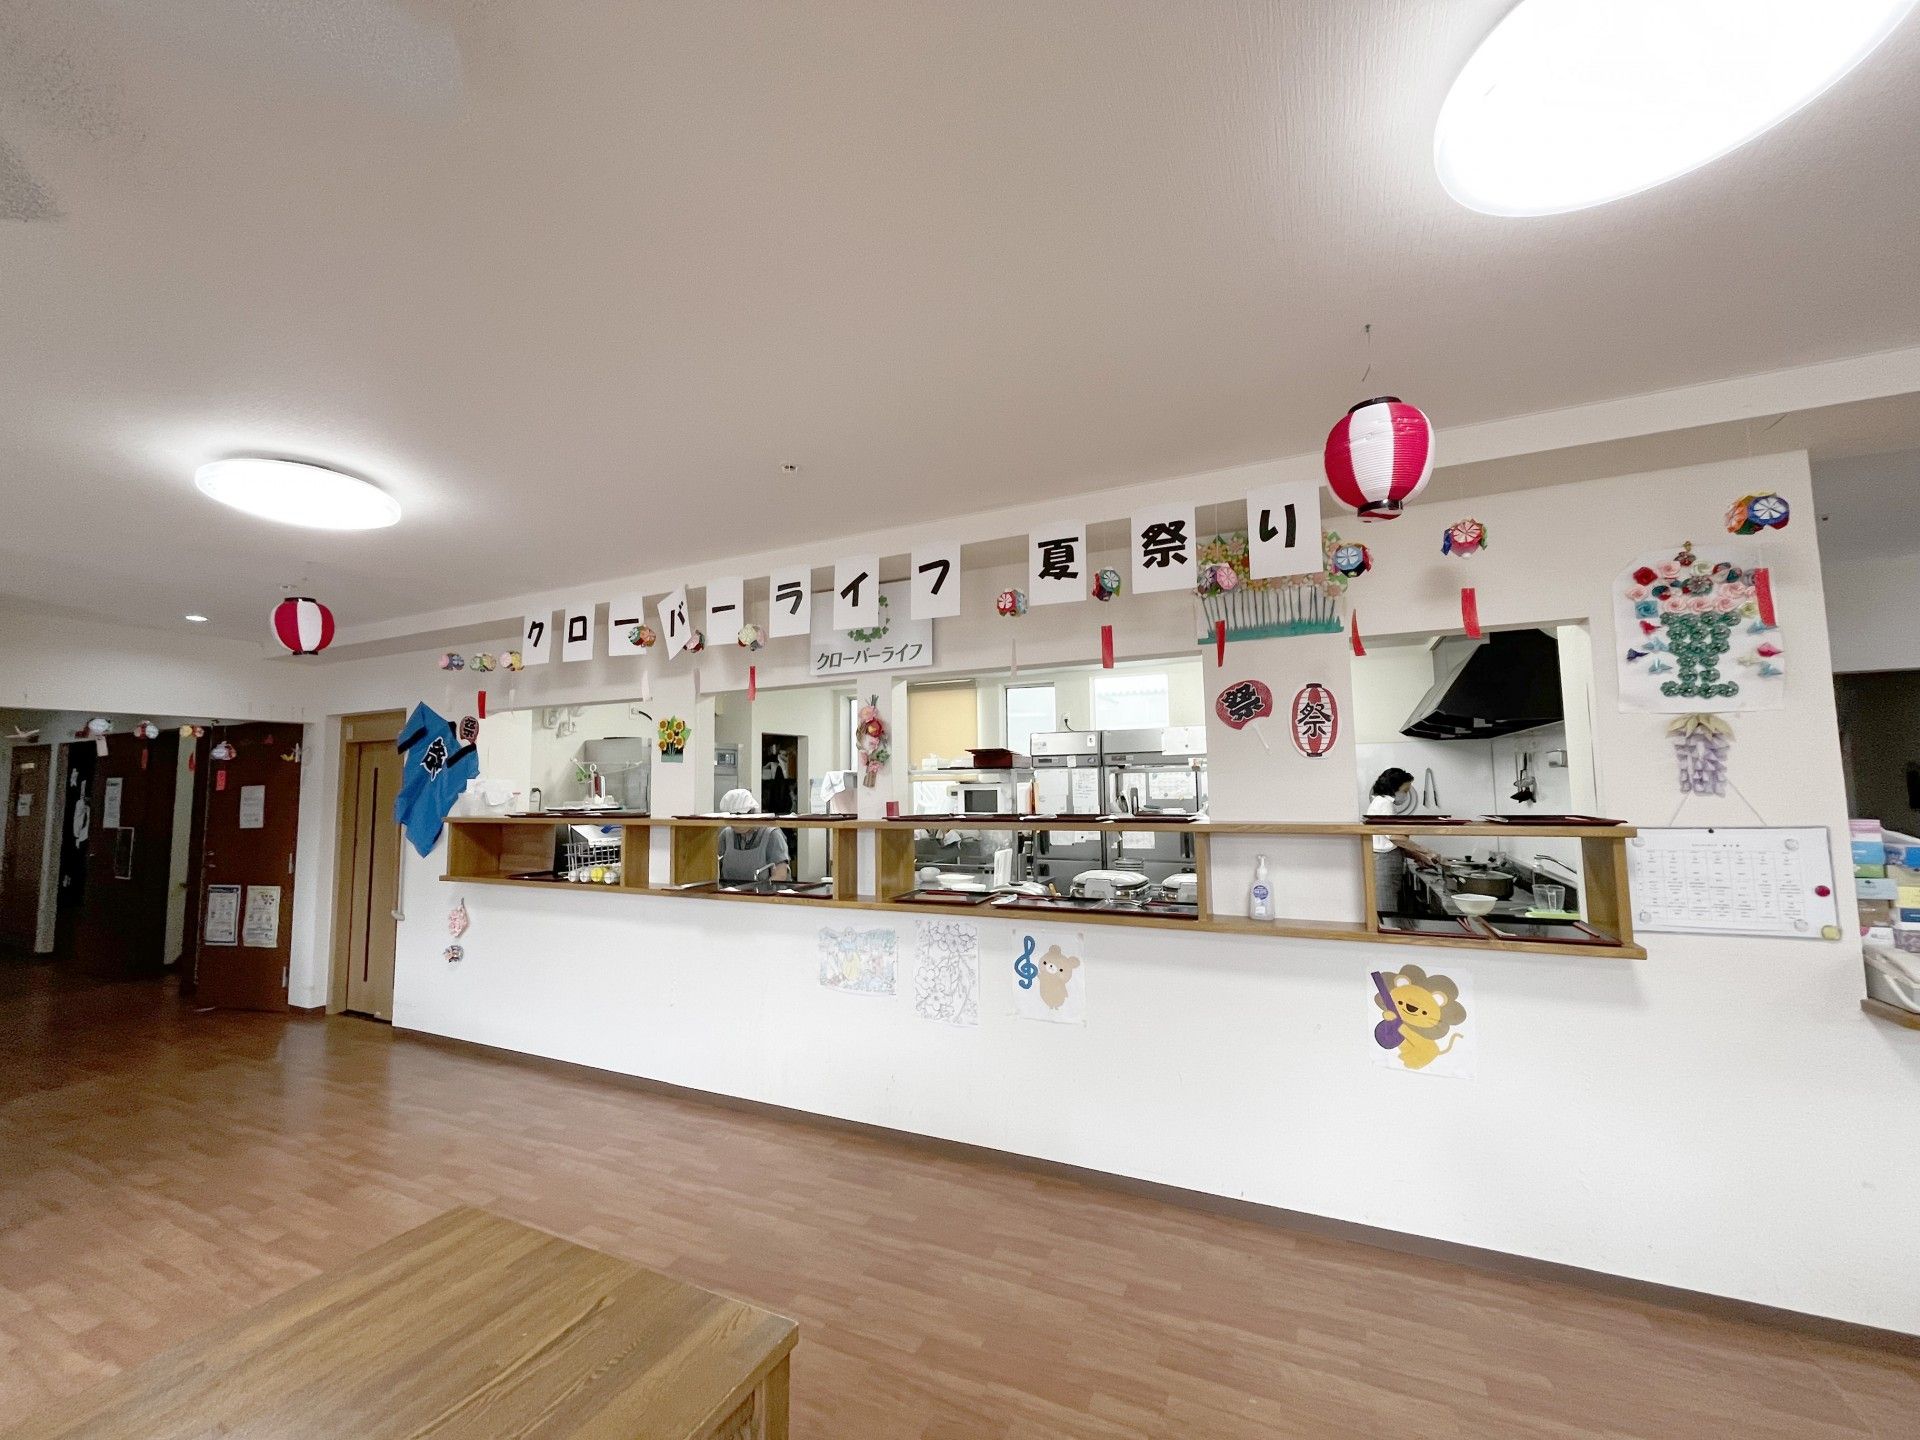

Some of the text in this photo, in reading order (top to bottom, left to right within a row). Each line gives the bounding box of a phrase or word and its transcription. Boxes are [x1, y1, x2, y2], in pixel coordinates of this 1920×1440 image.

[816, 643, 923, 671] クローバーライフ
[1221, 682, 1264, 722] 祭
[1297, 702, 1332, 738] 祭
